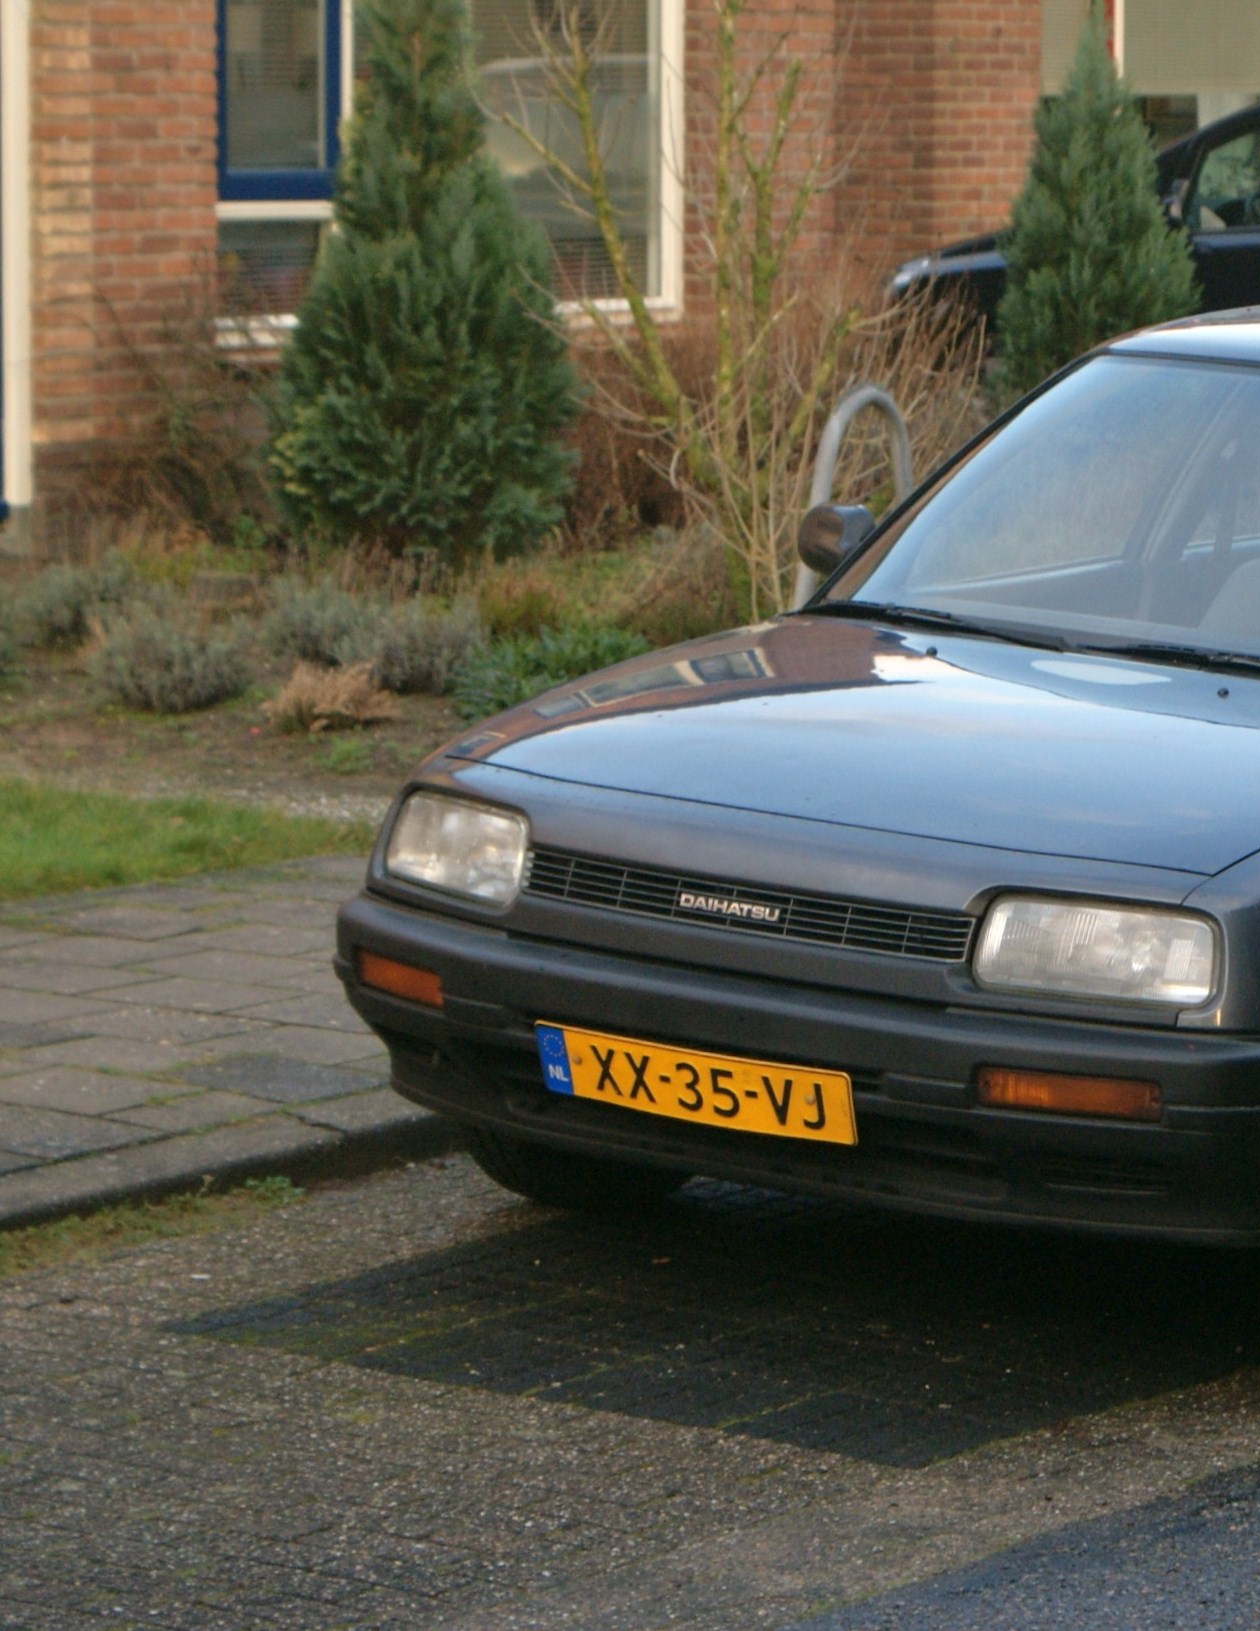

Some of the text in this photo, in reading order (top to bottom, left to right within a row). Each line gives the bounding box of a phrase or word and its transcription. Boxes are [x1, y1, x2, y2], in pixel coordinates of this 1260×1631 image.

[680, 893, 780, 921] DAIHATSU
[549, 1064, 570, 1083] NL
[590, 1045, 826, 1130] XX-35-VJ
